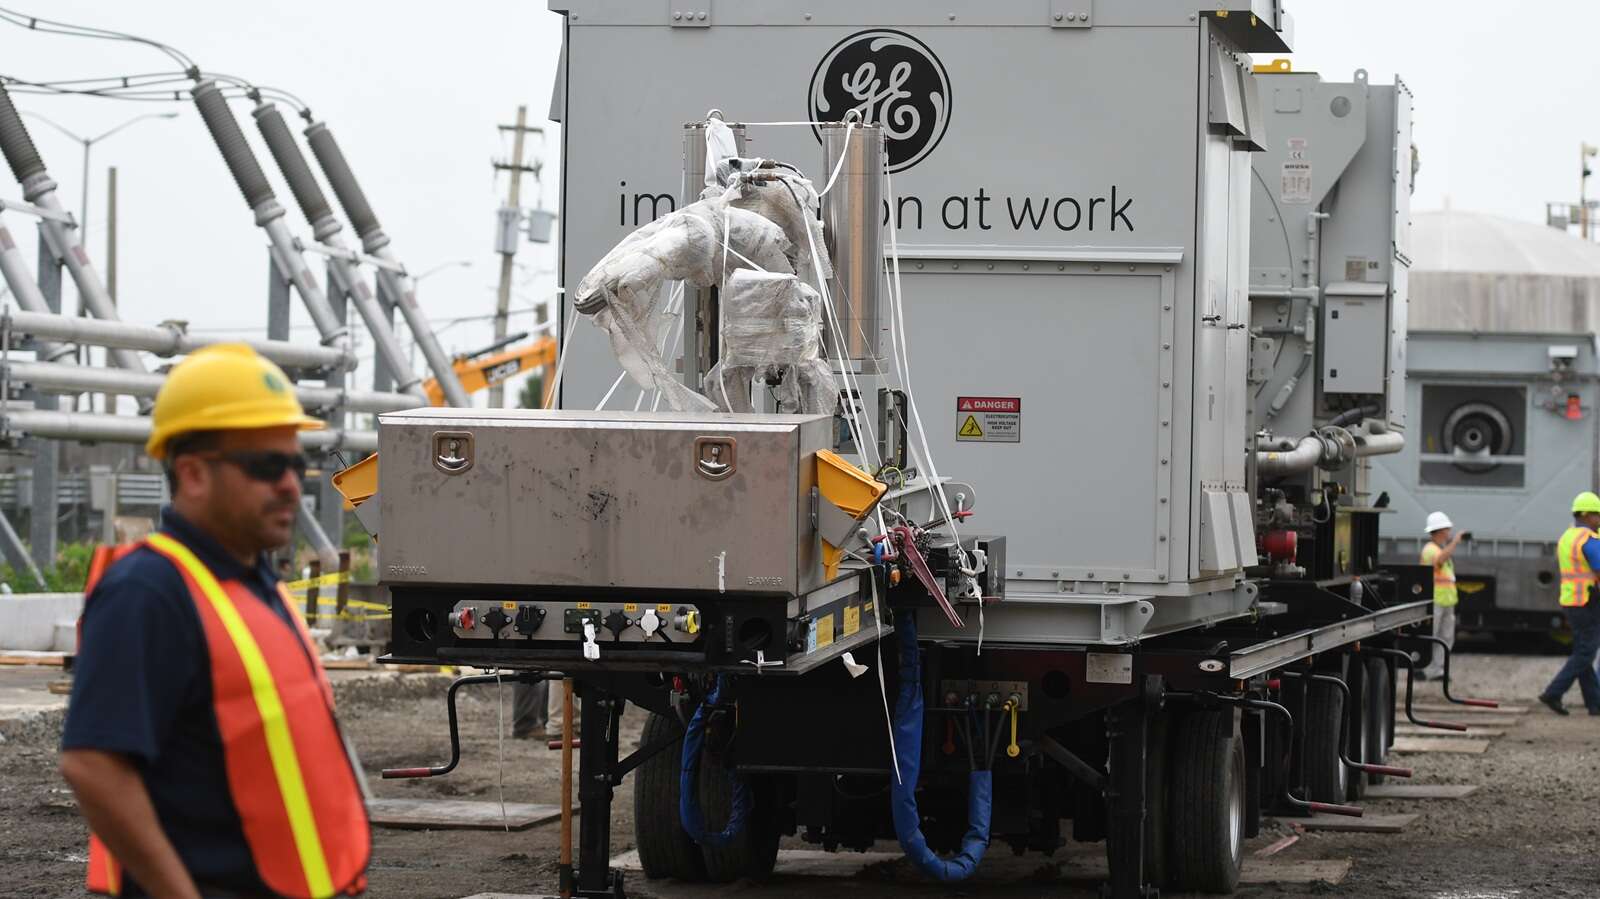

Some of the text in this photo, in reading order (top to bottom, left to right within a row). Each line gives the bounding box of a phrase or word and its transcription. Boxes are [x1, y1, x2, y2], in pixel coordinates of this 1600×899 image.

[842, 61, 921, 141] GE
[942, 188, 992, 230] at
[1006, 185, 1134, 231] work
[974, 401, 1015, 409] DANGER
